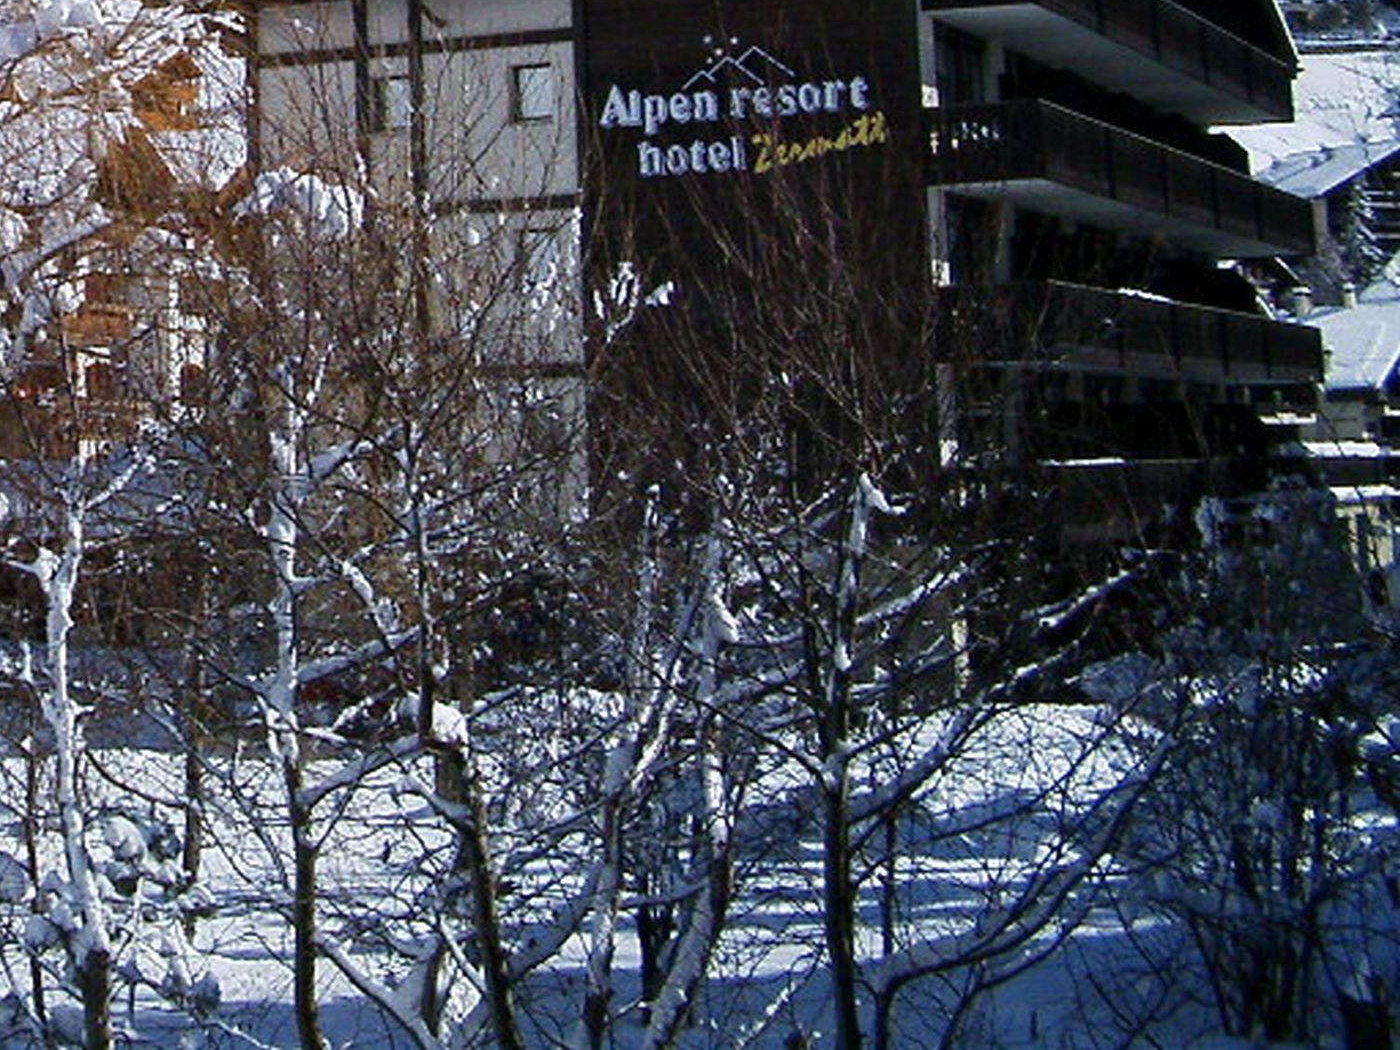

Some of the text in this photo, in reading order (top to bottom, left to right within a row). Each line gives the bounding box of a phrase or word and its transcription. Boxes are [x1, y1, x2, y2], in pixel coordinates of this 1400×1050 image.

[599, 75, 869, 135] Alpen resort
[637, 134, 747, 177] hotel
